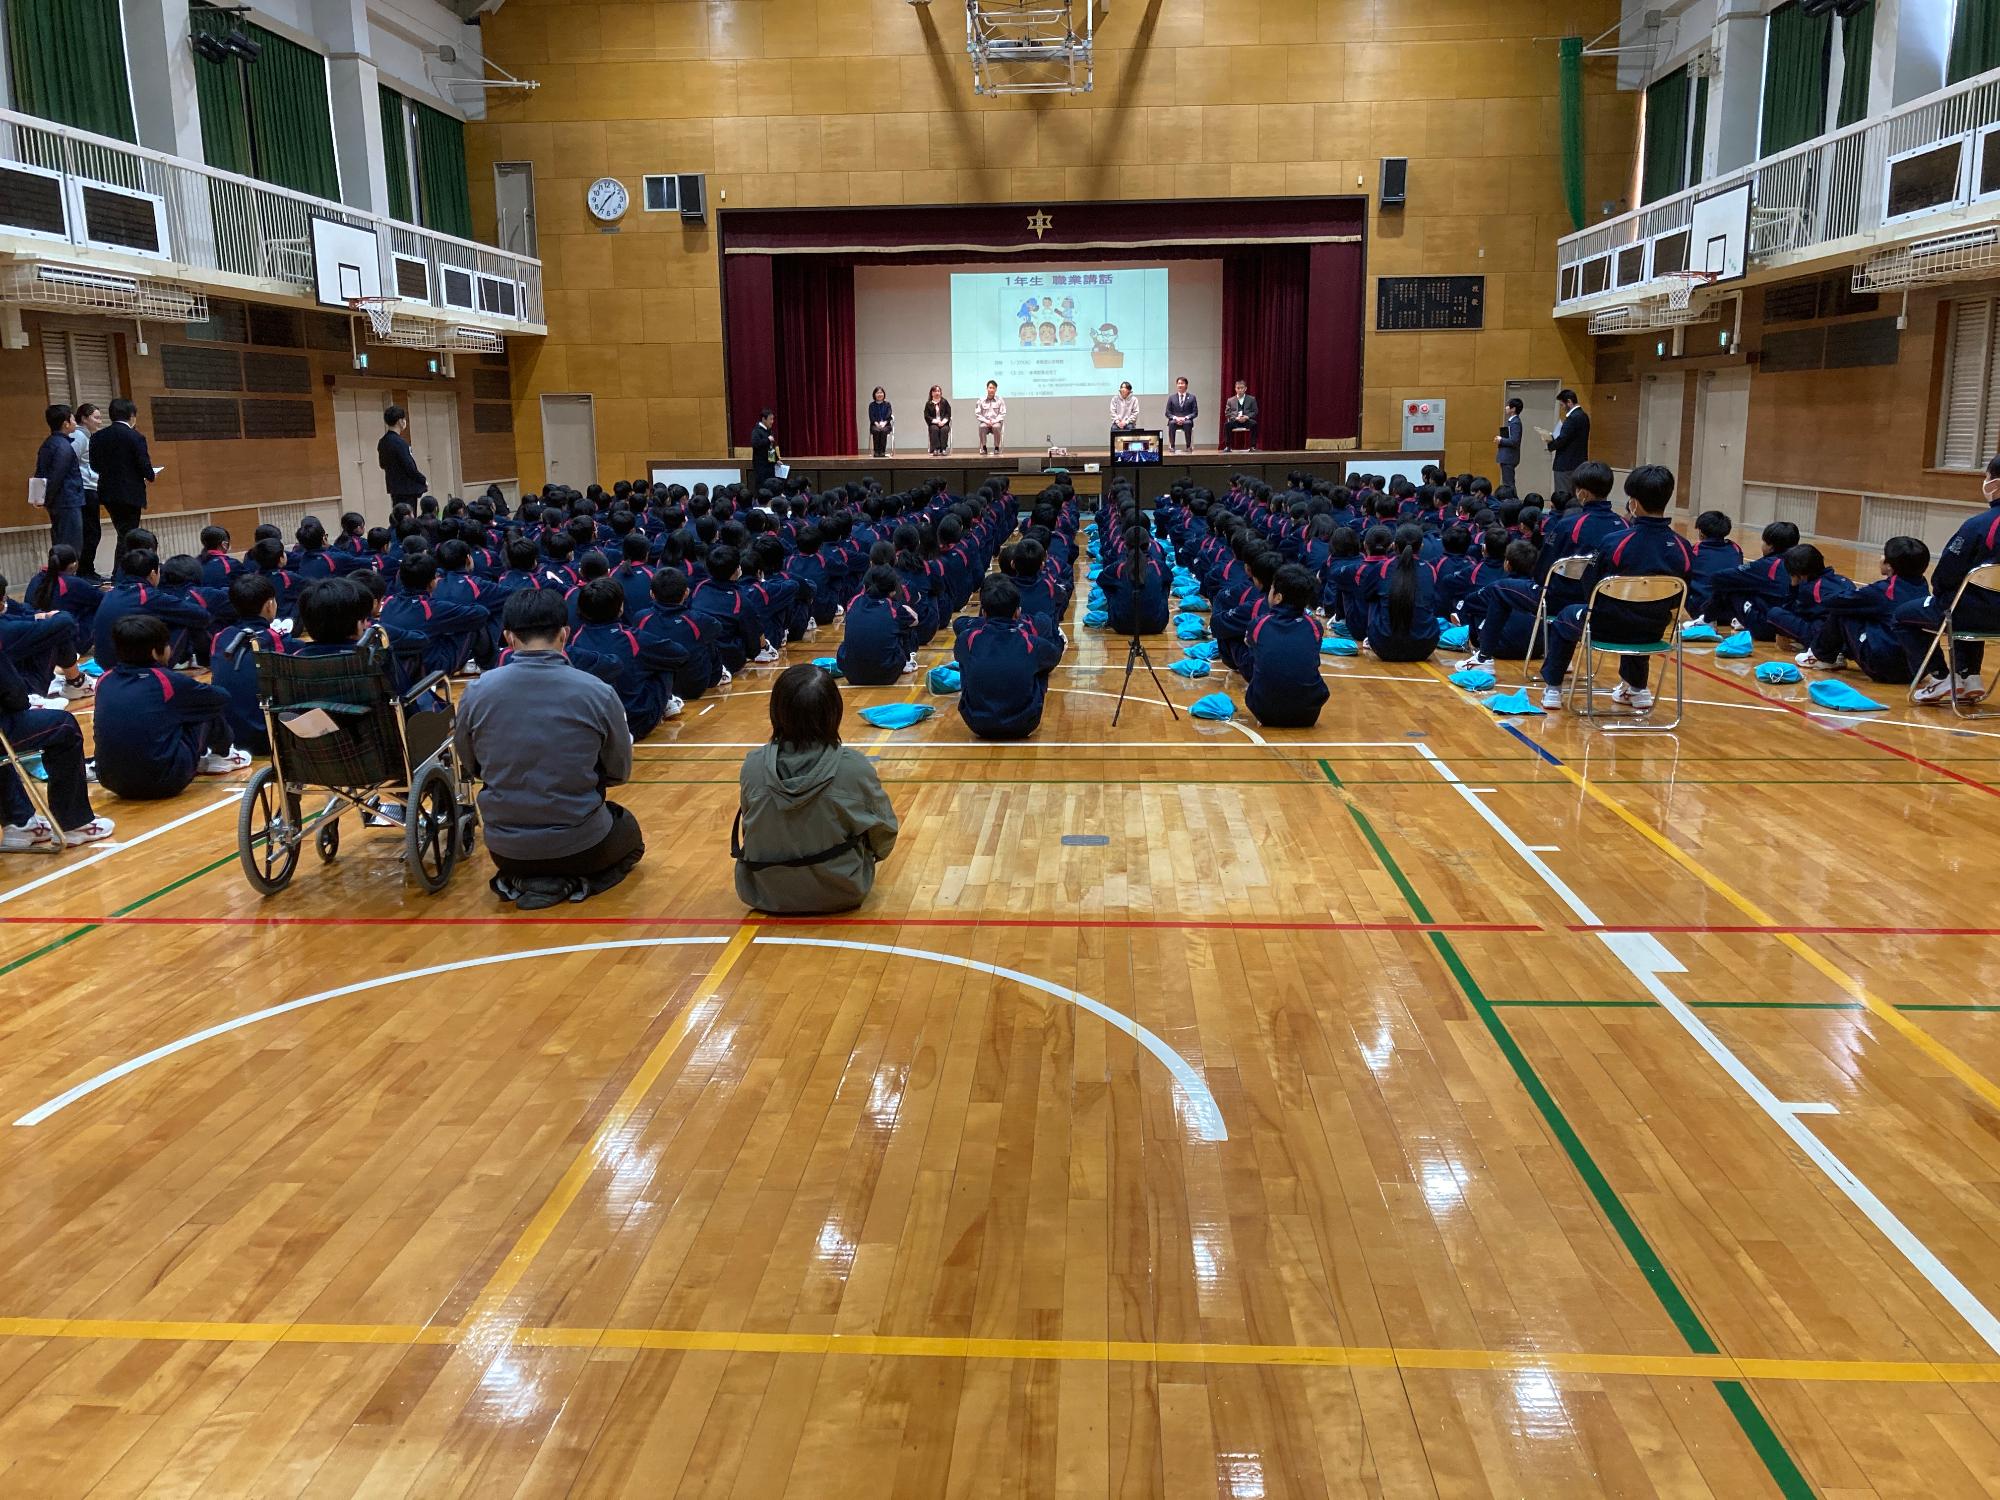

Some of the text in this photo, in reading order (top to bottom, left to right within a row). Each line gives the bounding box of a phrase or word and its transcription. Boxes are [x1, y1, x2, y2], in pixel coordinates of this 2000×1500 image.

[1005, 274, 1113, 286] 1年生 職業講話
